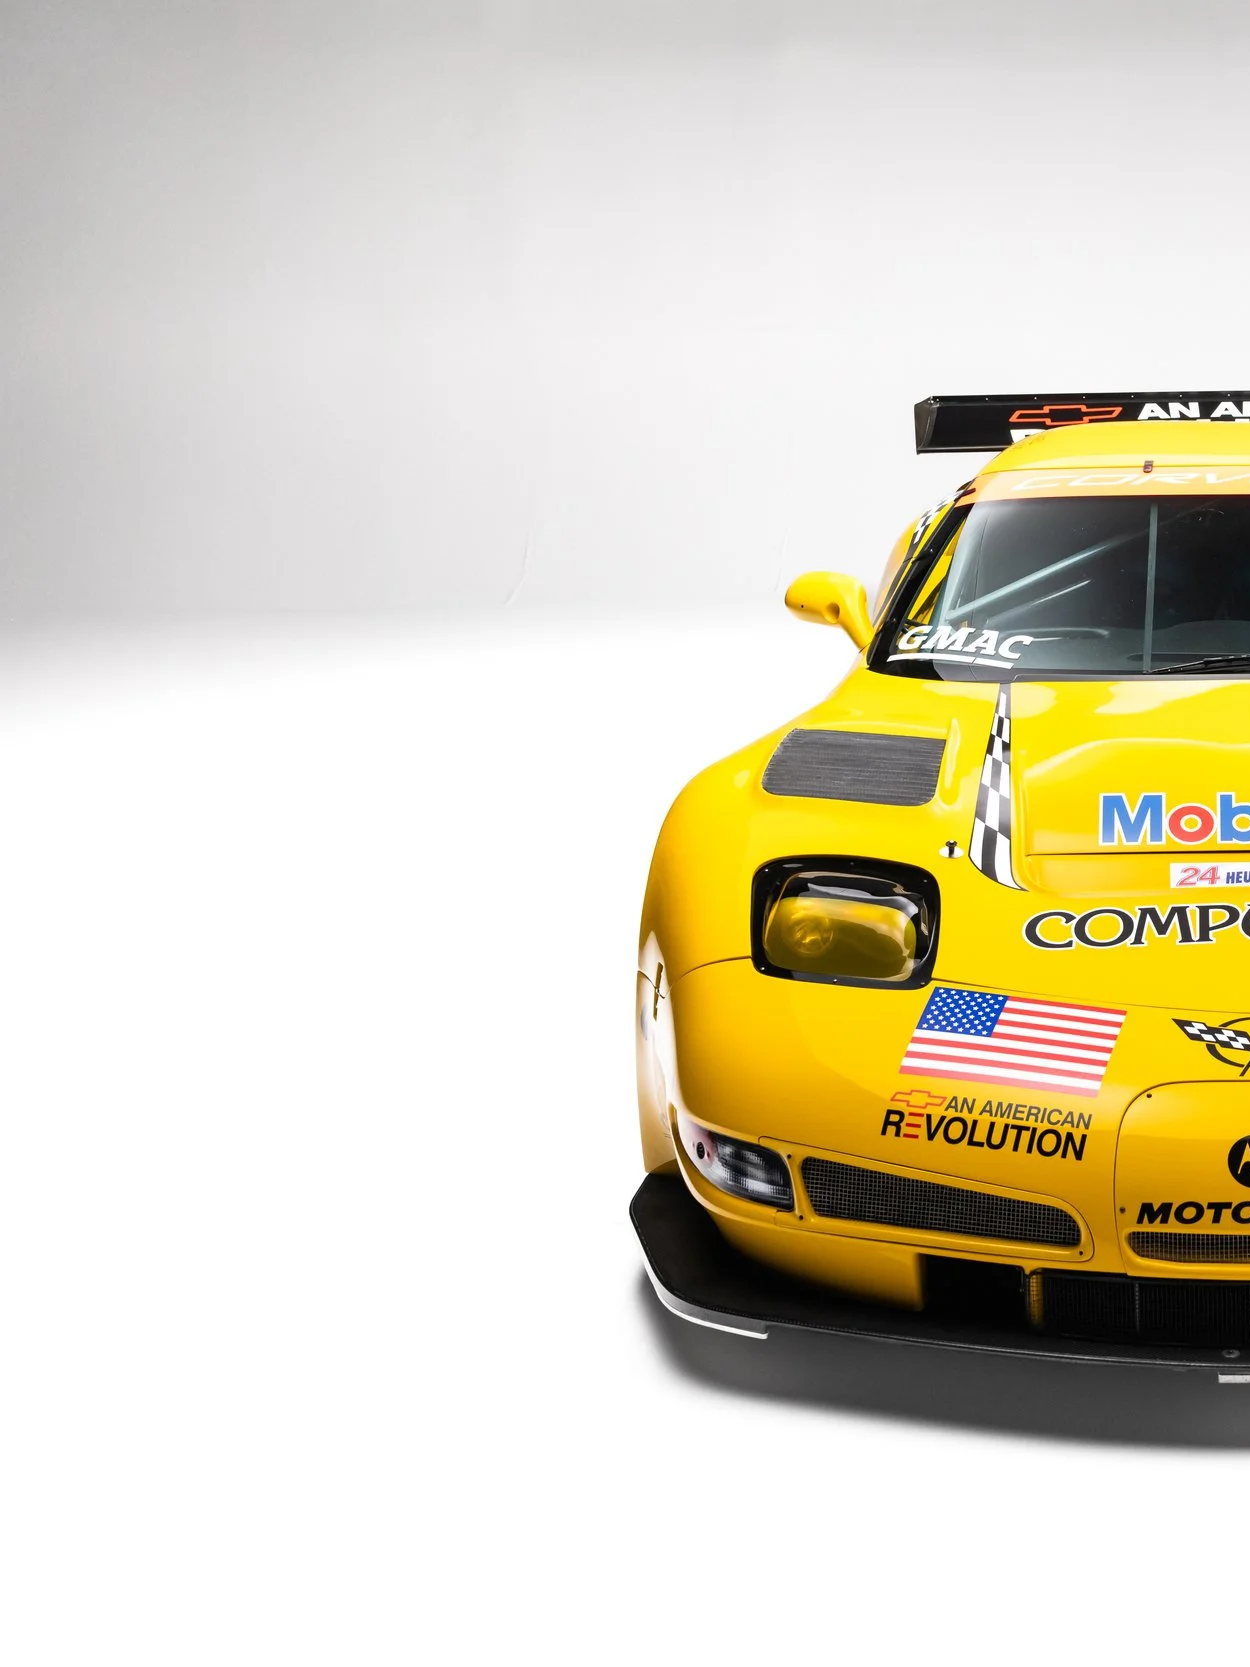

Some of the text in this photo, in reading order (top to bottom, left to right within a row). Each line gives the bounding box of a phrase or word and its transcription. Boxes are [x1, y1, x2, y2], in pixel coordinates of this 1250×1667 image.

[1138, 402, 1200, 420] AN
[898, 625, 1034, 660] GMAC
[1176, 865, 1220, 886] 24
[944, 1096, 1092, 1130] AN AMERICAN
[881, 1109, 1088, 1161] REVOLUTION
